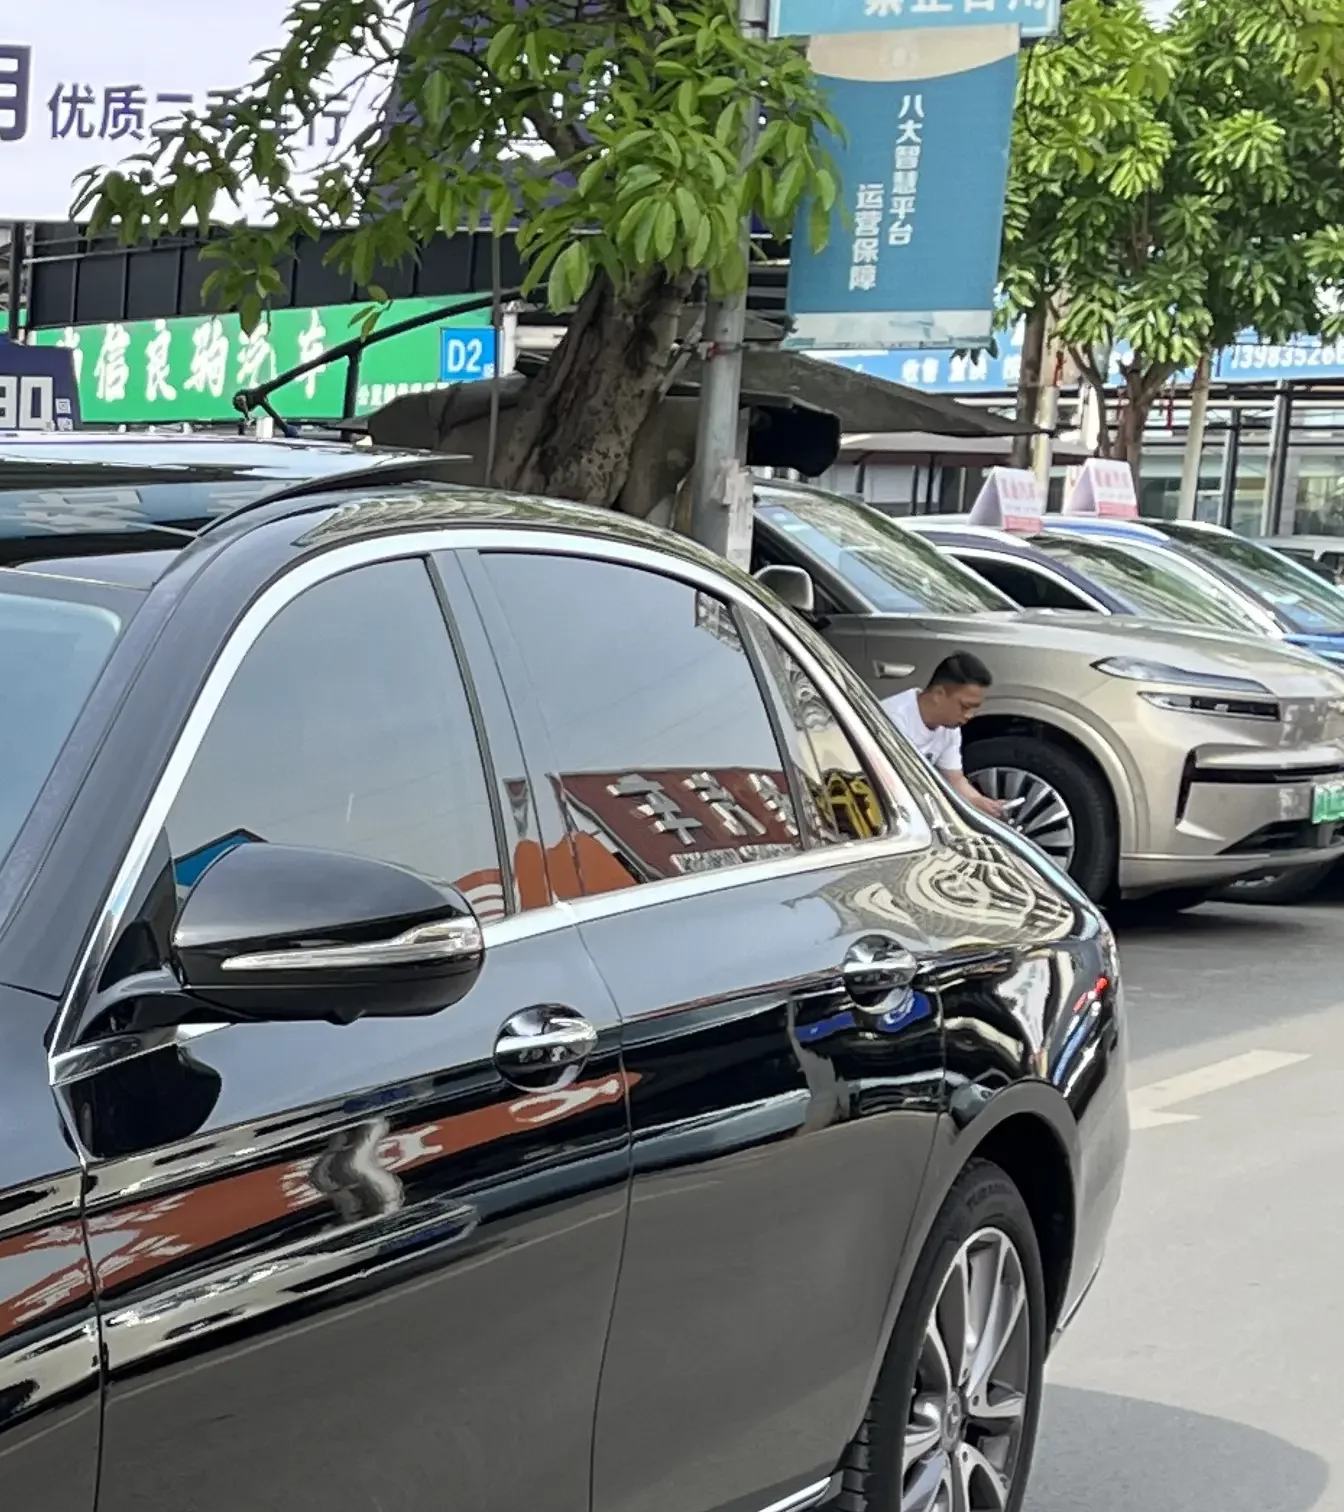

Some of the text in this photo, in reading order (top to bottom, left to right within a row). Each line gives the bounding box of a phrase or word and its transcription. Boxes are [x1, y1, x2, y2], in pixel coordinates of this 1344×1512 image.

[888, 94, 925, 245] 八大智慧平台
[849, 183, 884, 291] 运营保障
[447, 337, 484, 373] D2
